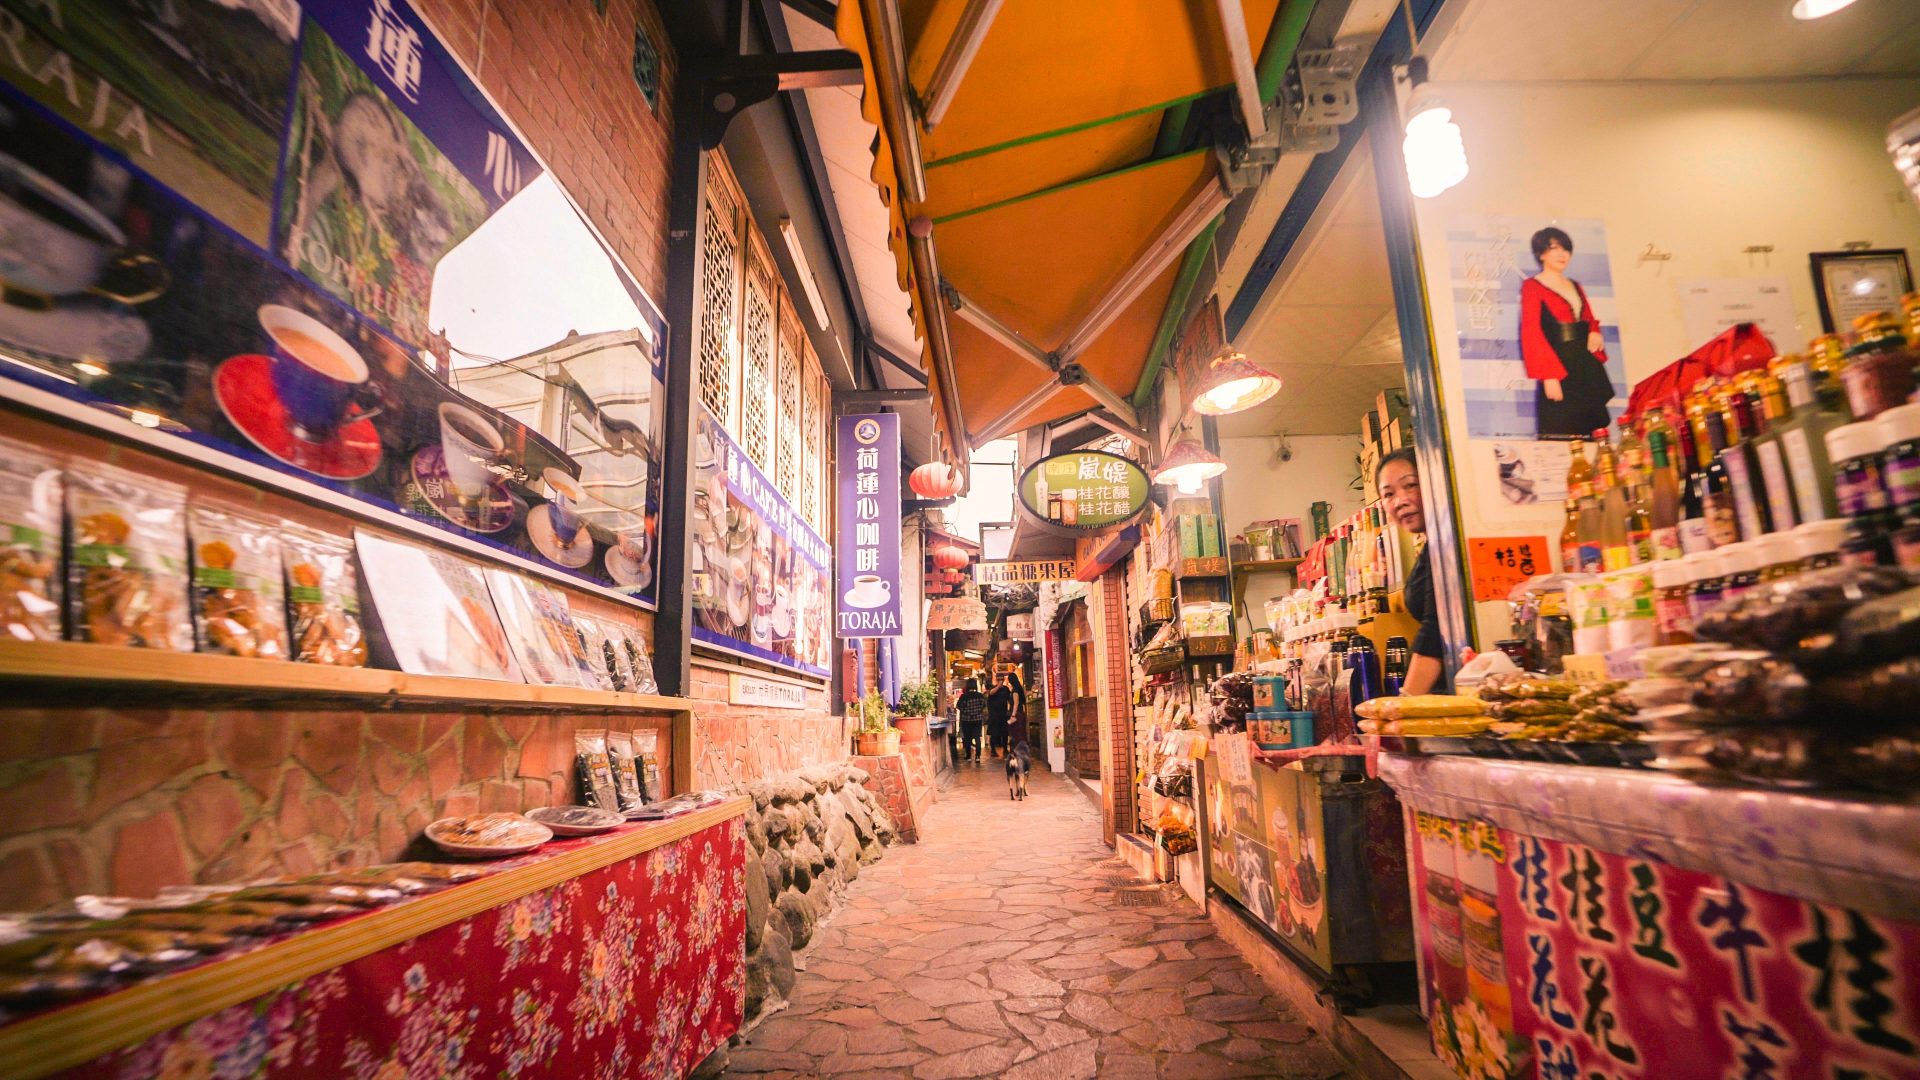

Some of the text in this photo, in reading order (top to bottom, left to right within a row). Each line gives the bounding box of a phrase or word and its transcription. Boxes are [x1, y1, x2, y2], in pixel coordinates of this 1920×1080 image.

[856, 447, 879, 572] 荷蓮心咖啡
[1078, 501, 1131, 515] 桂花醋
[984, 561, 1075, 582] 精品糖果屋
[839, 611, 897, 633] TORAJA
[1560, 847, 1640, 1080] 桂花
